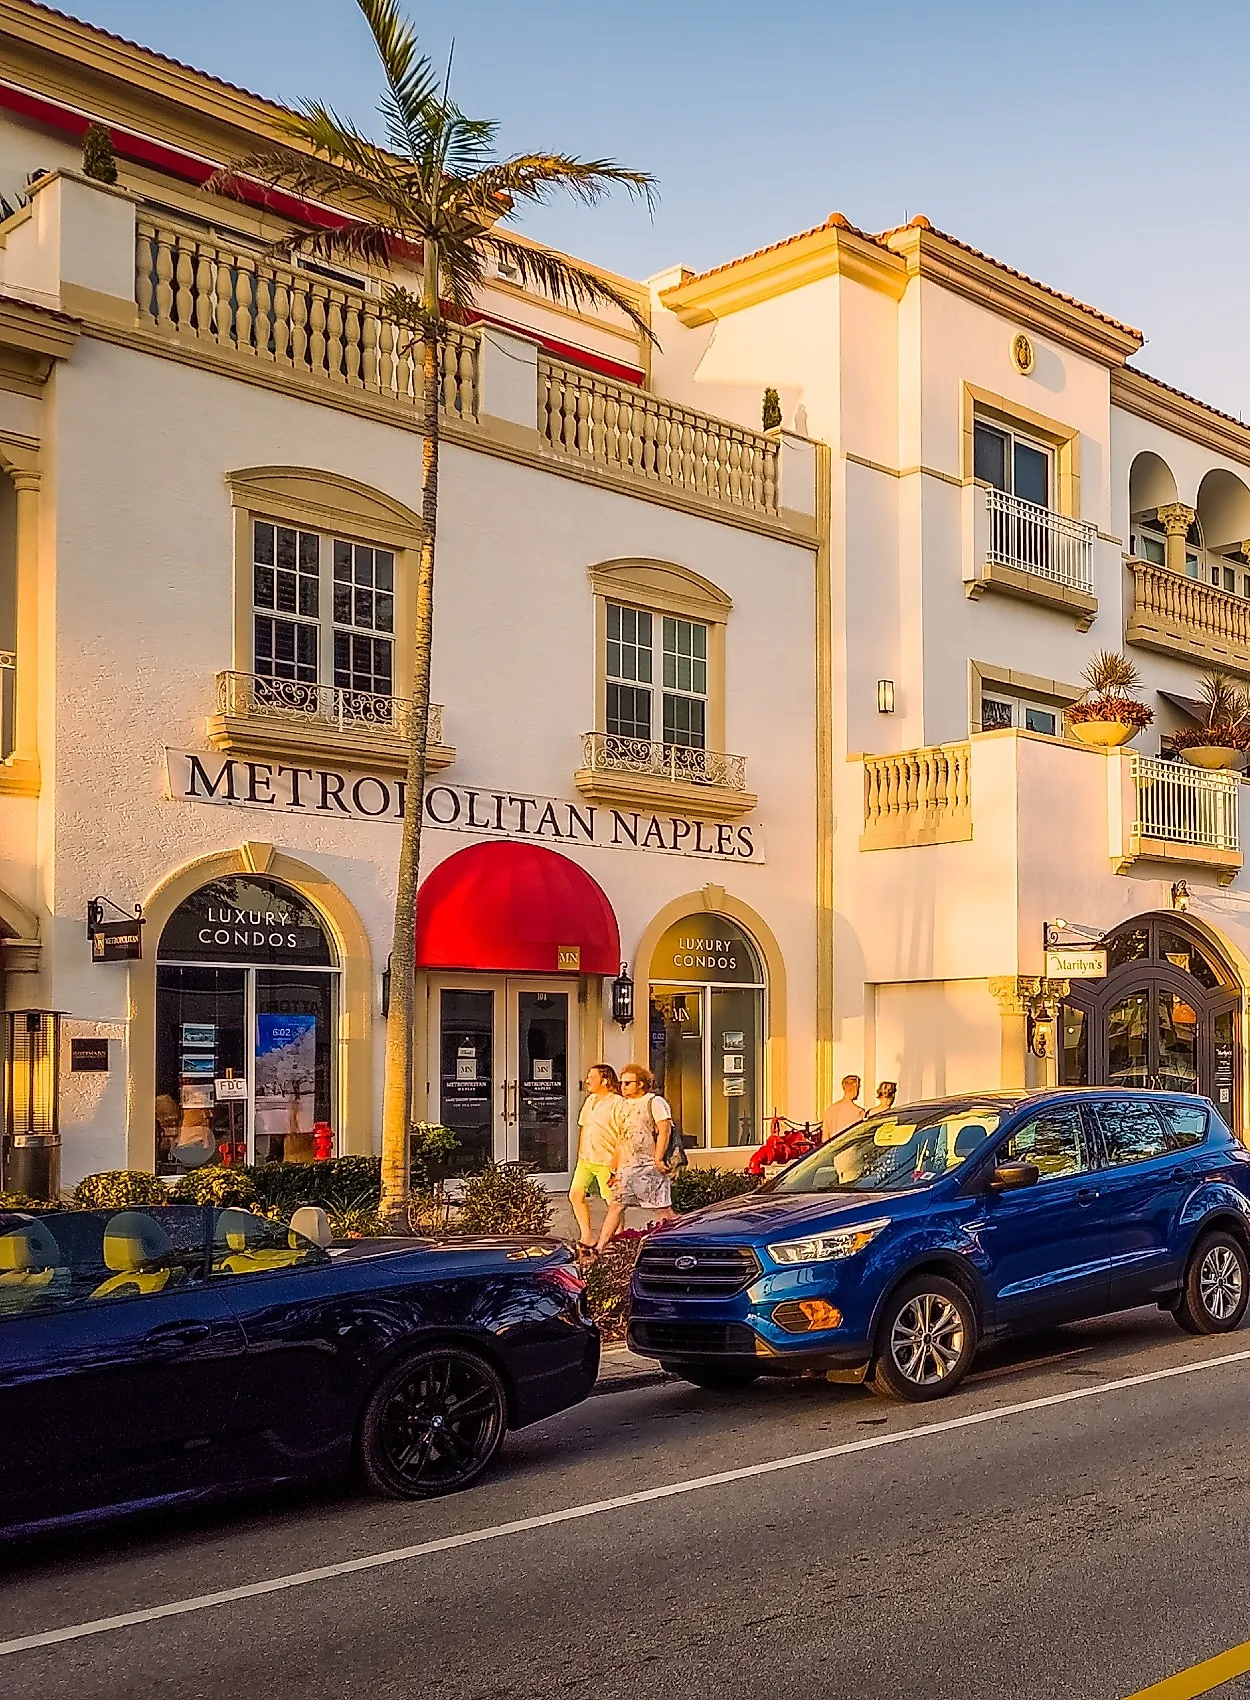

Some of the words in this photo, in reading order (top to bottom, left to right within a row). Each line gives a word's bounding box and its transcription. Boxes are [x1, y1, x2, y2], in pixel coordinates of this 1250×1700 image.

[610, 809, 754, 858] NAPLES
[208, 908, 289, 926] LUXURY
[199, 929, 297, 948] CONDOS
[679, 937, 731, 953] LUXURY
[559, 952, 578, 963] MN
[673, 954, 737, 970] CONDOS
[1051, 956, 1102, 974] Marilyn's
[220, 1080, 244, 1091] FDC
